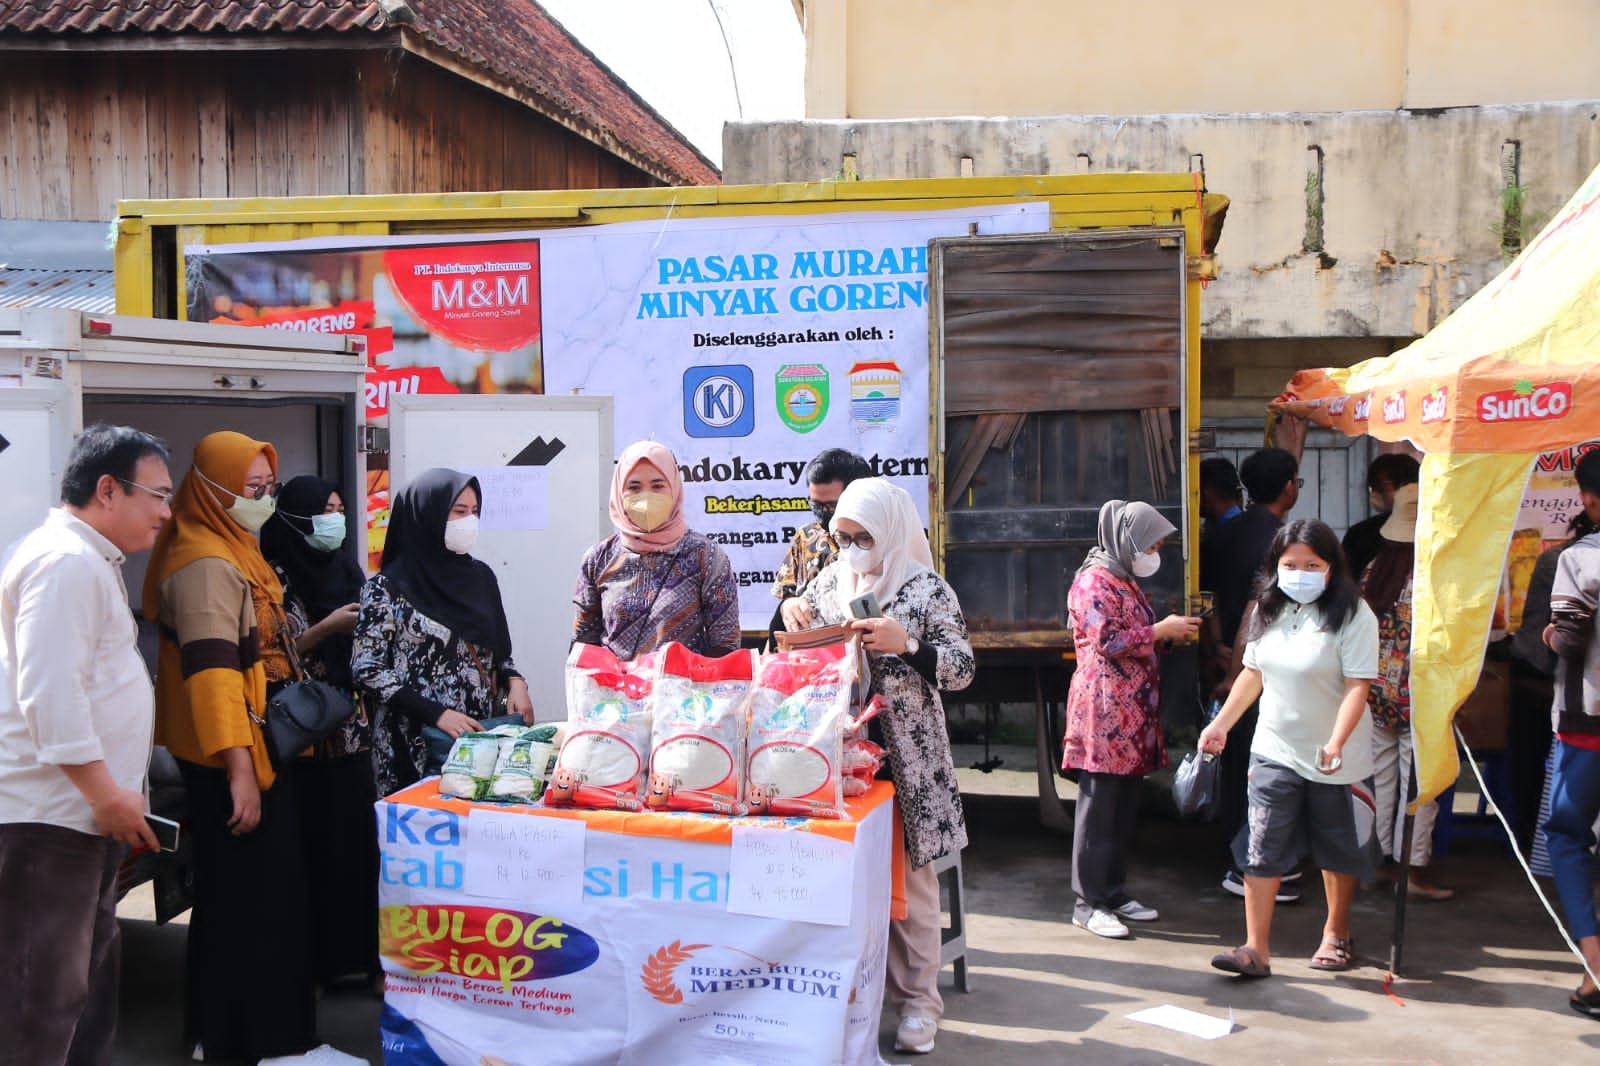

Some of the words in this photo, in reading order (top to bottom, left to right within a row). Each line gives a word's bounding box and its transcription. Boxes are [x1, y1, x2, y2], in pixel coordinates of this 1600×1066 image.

[657, 254, 779, 284] PASAR
[790, 246, 928, 279] MURAH
[432, 275, 529, 309] M&M
[636, 288, 779, 319] MINYAK
[789, 280, 928, 313] GOREN
[693, 331, 840, 347] Diselenggarakan
[845, 326, 883, 341] oleh
[1481, 387, 1567, 421] SunCo
[704, 494, 812, 515] Bekerjasam
[384, 906, 568, 950] BULOG
[400, 938, 534, 989] Siap
[690, 966, 761, 978] BERAS
[767, 965, 842, 981] BULOG
[432, 986, 467, 1001] Harga
[463, 979, 504, 993] Beras
[512, 986, 571, 1000] Medium
[689, 976, 840, 999] MEDIUM
[714, 1023, 738, 1037] 50
